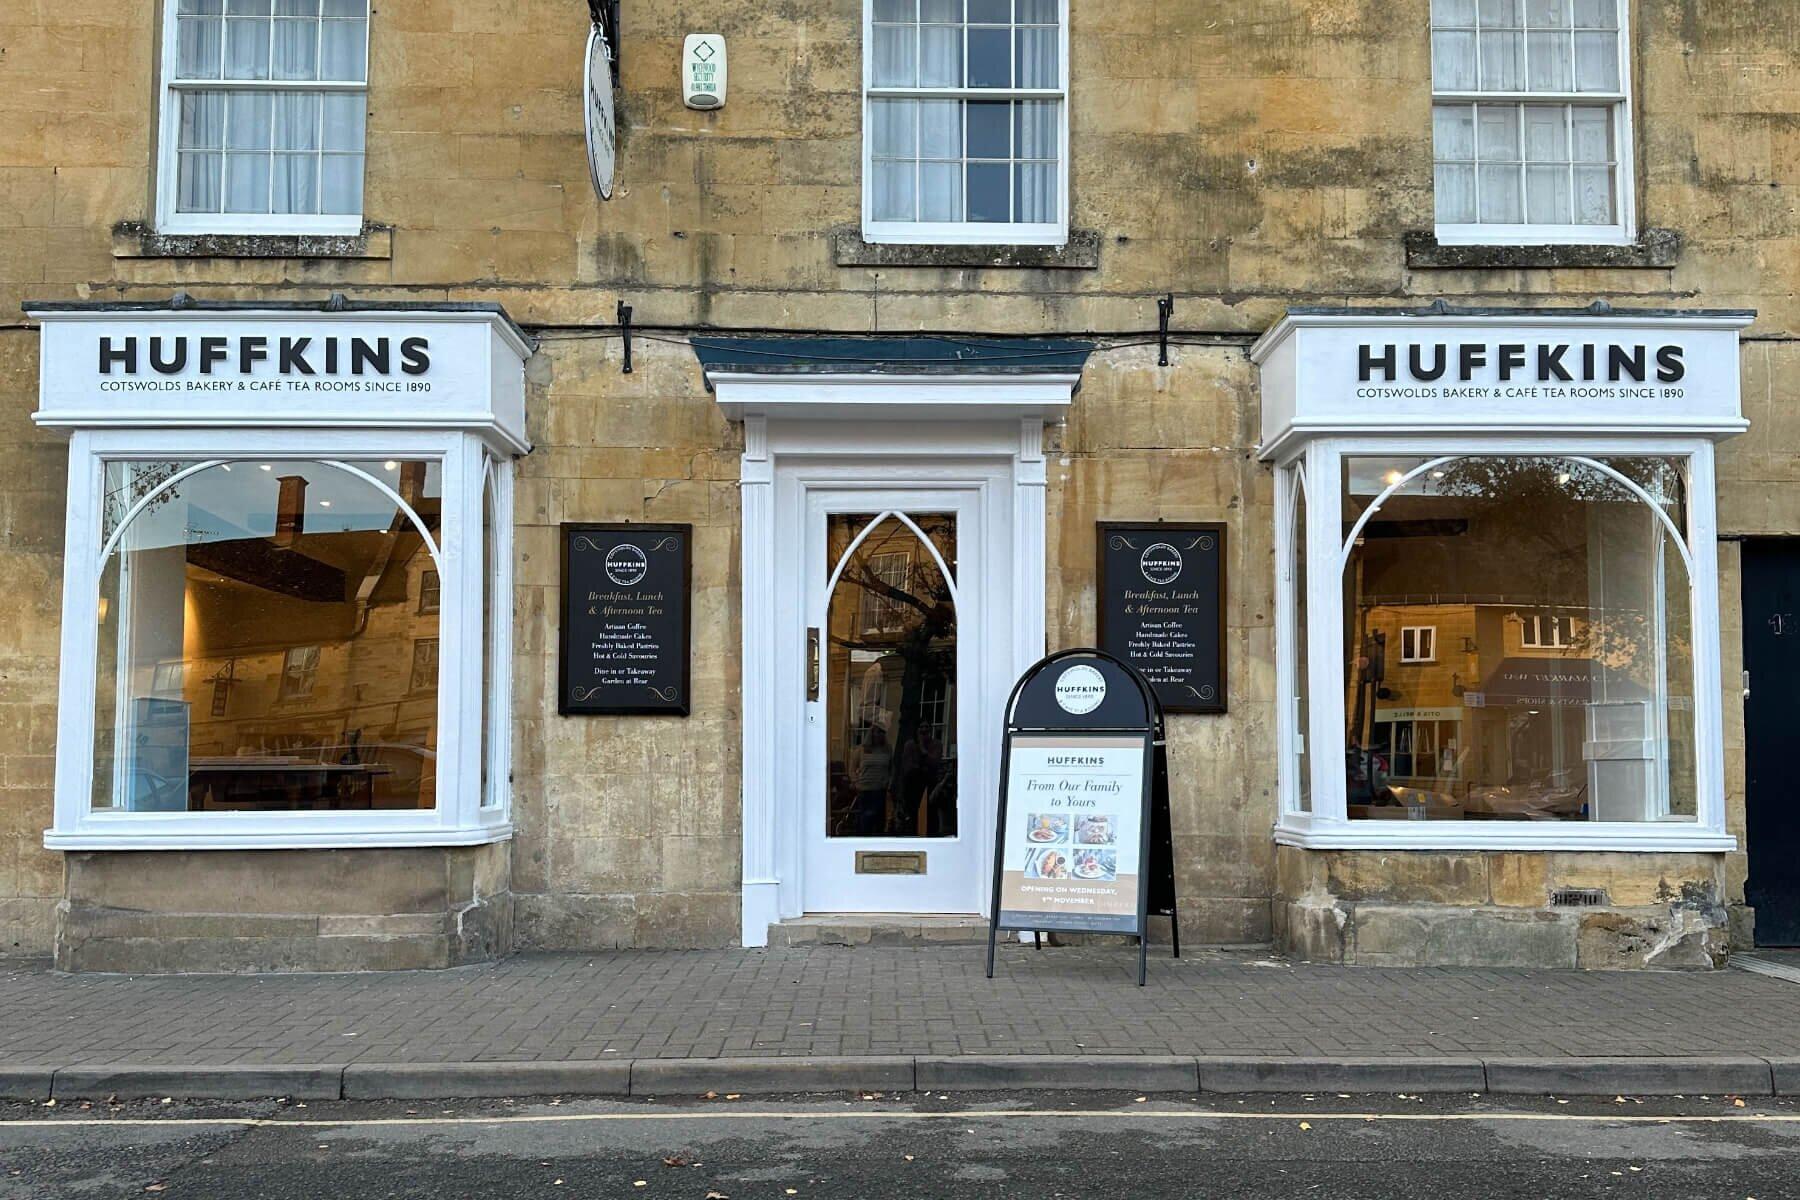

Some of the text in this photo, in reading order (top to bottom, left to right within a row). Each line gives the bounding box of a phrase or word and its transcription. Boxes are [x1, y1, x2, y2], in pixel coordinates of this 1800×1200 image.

[99, 336, 431, 375] HUFFKINS
[1358, 344, 1686, 382] HUFFKINS
[100, 378, 431, 392] COTSWOLDS BAKERY & CAFÉ TEA ROOMS SINCE 1890
[1356, 385, 1684, 398] COTSWOLDS BAKERY & CAFÉ TEA ROOMS SINCE 1890
[588, 592, 664, 602] Breakfast, Lunch
[1124, 590, 1199, 602] Breakfast, Lunch
[588, 605, 663, 617] & Afternoon Tea
[1124, 604, 1198, 616] & Afternoon Tea
[1128, 641, 1150, 649] Freshly
[626, 668, 656, 676] Takeaway
[1163, 666, 1192, 675] Takeaway
[1027, 780, 1123, 796] From Our Family
[1051, 796, 1096, 807] to Yours
[1020, 885, 1054, 893] OPENING
[1069, 886, 1118, 896] WEDNESDAY,
[1054, 897, 1094, 905] NOVEMBER
